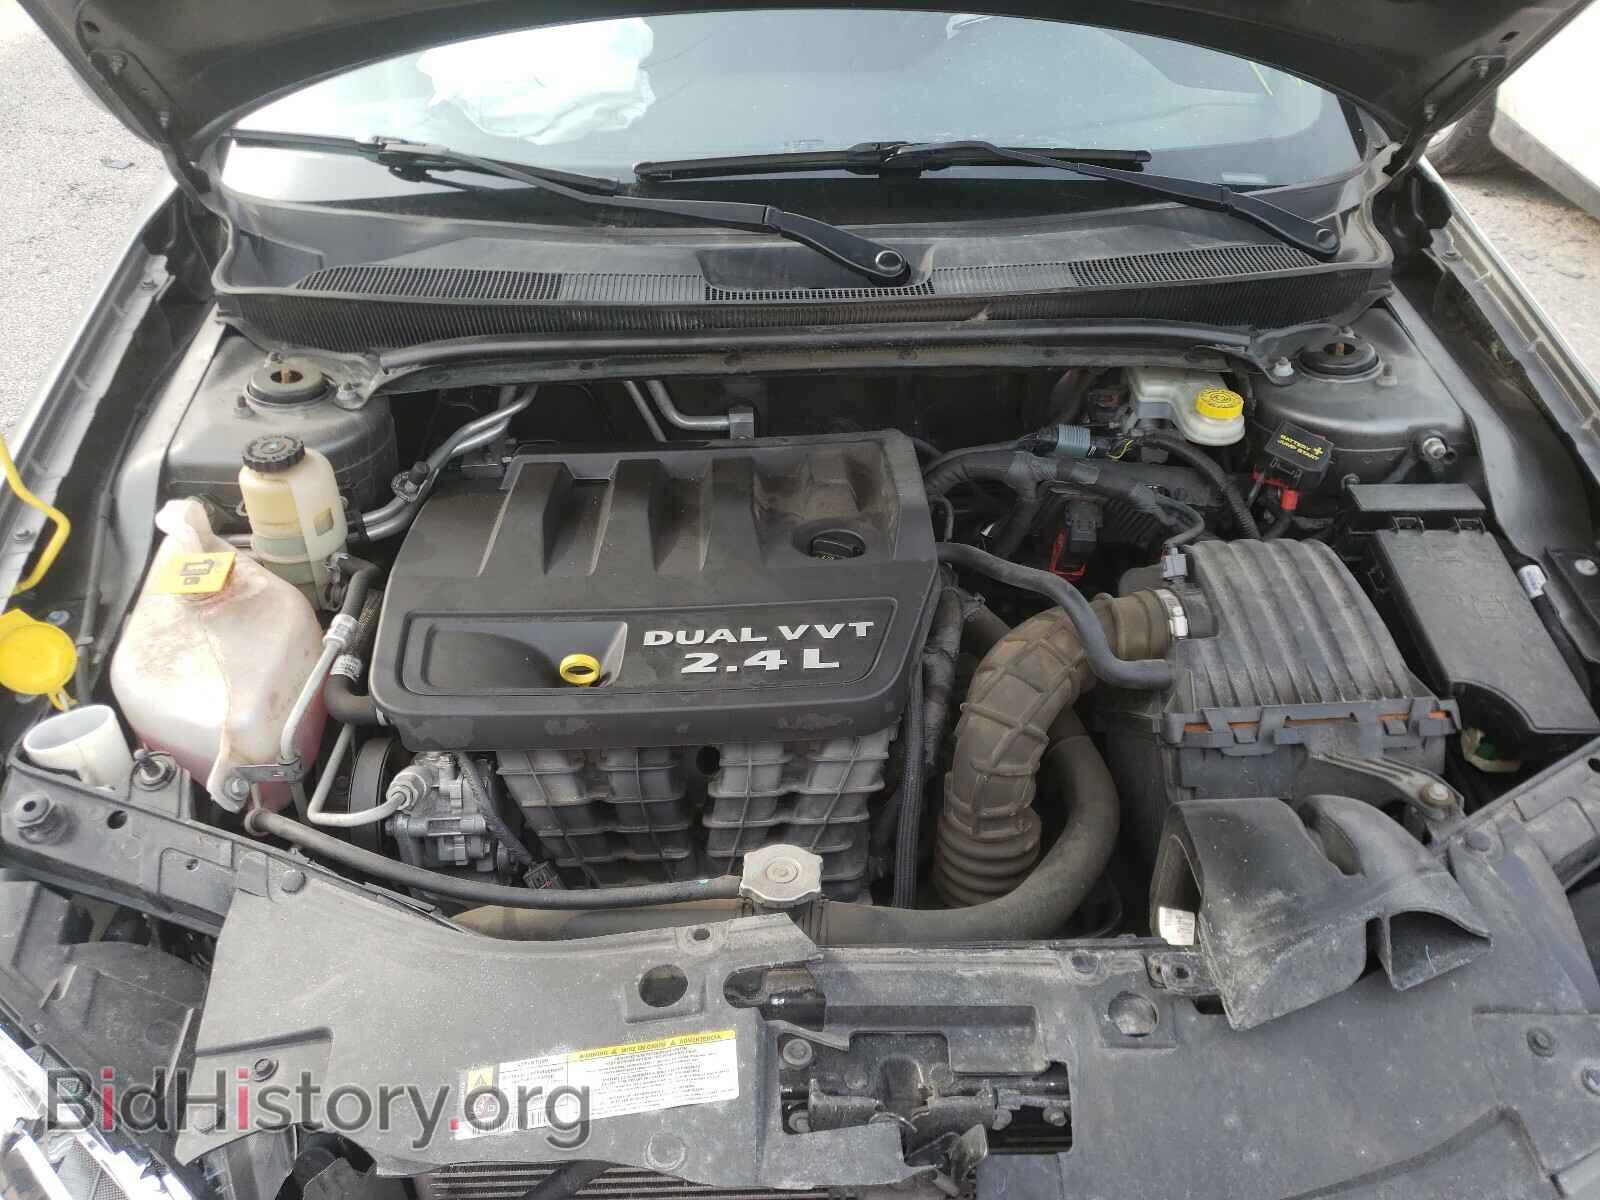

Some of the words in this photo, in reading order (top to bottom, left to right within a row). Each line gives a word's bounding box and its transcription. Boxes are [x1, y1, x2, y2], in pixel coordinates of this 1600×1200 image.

[1280, 434, 1311, 450] BATTERY
[643, 627, 768, 646] DUAL
[777, 621, 875, 641] VVT
[680, 649, 788, 674] 2.4
[802, 648, 840, 669] L
